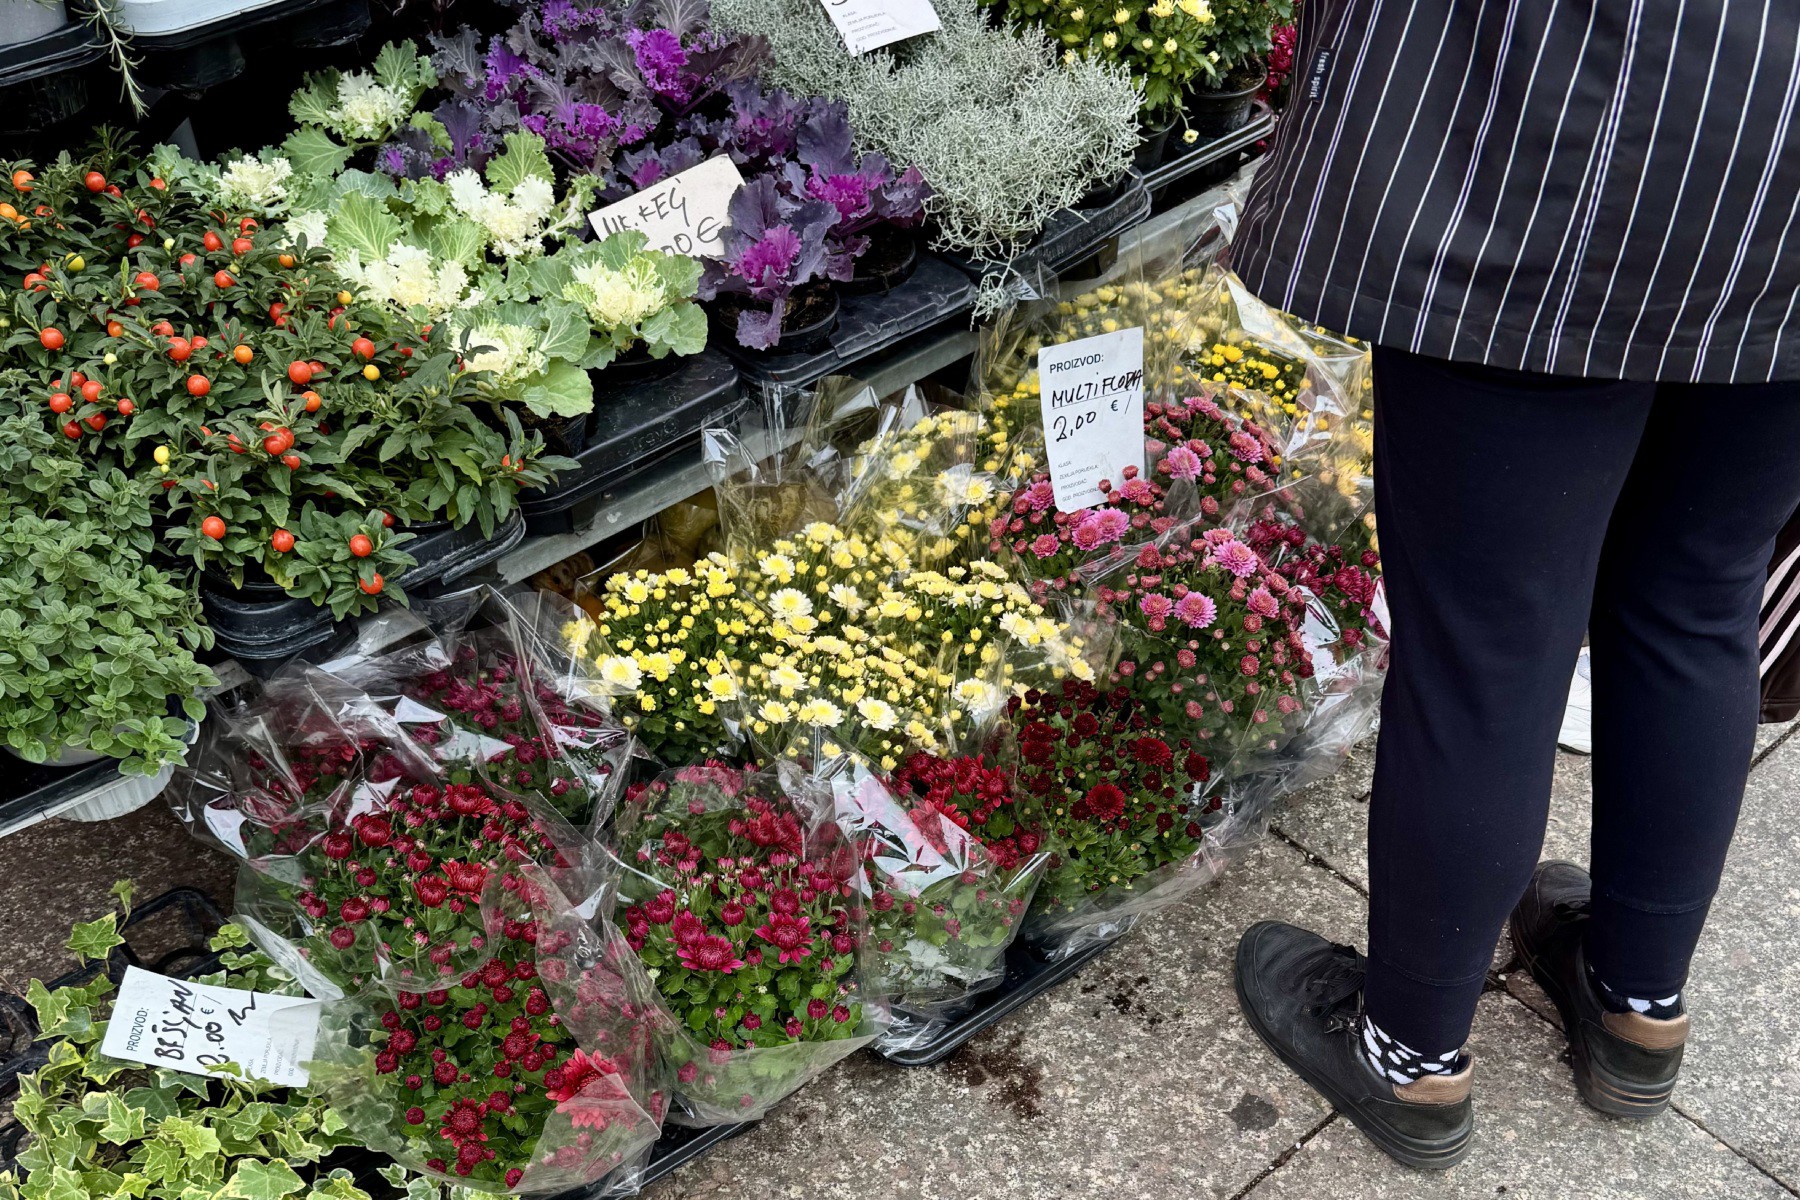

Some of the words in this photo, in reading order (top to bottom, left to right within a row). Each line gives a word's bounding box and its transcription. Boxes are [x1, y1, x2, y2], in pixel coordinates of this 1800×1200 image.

[1316, 51, 1330, 74] fresh
[1309, 76, 1320, 98] spirit
[1049, 353, 1104, 374] PROIZVOD:
[1053, 411, 1097, 442] 2,00
[126, 1007, 149, 1052] PROIZVOD:
